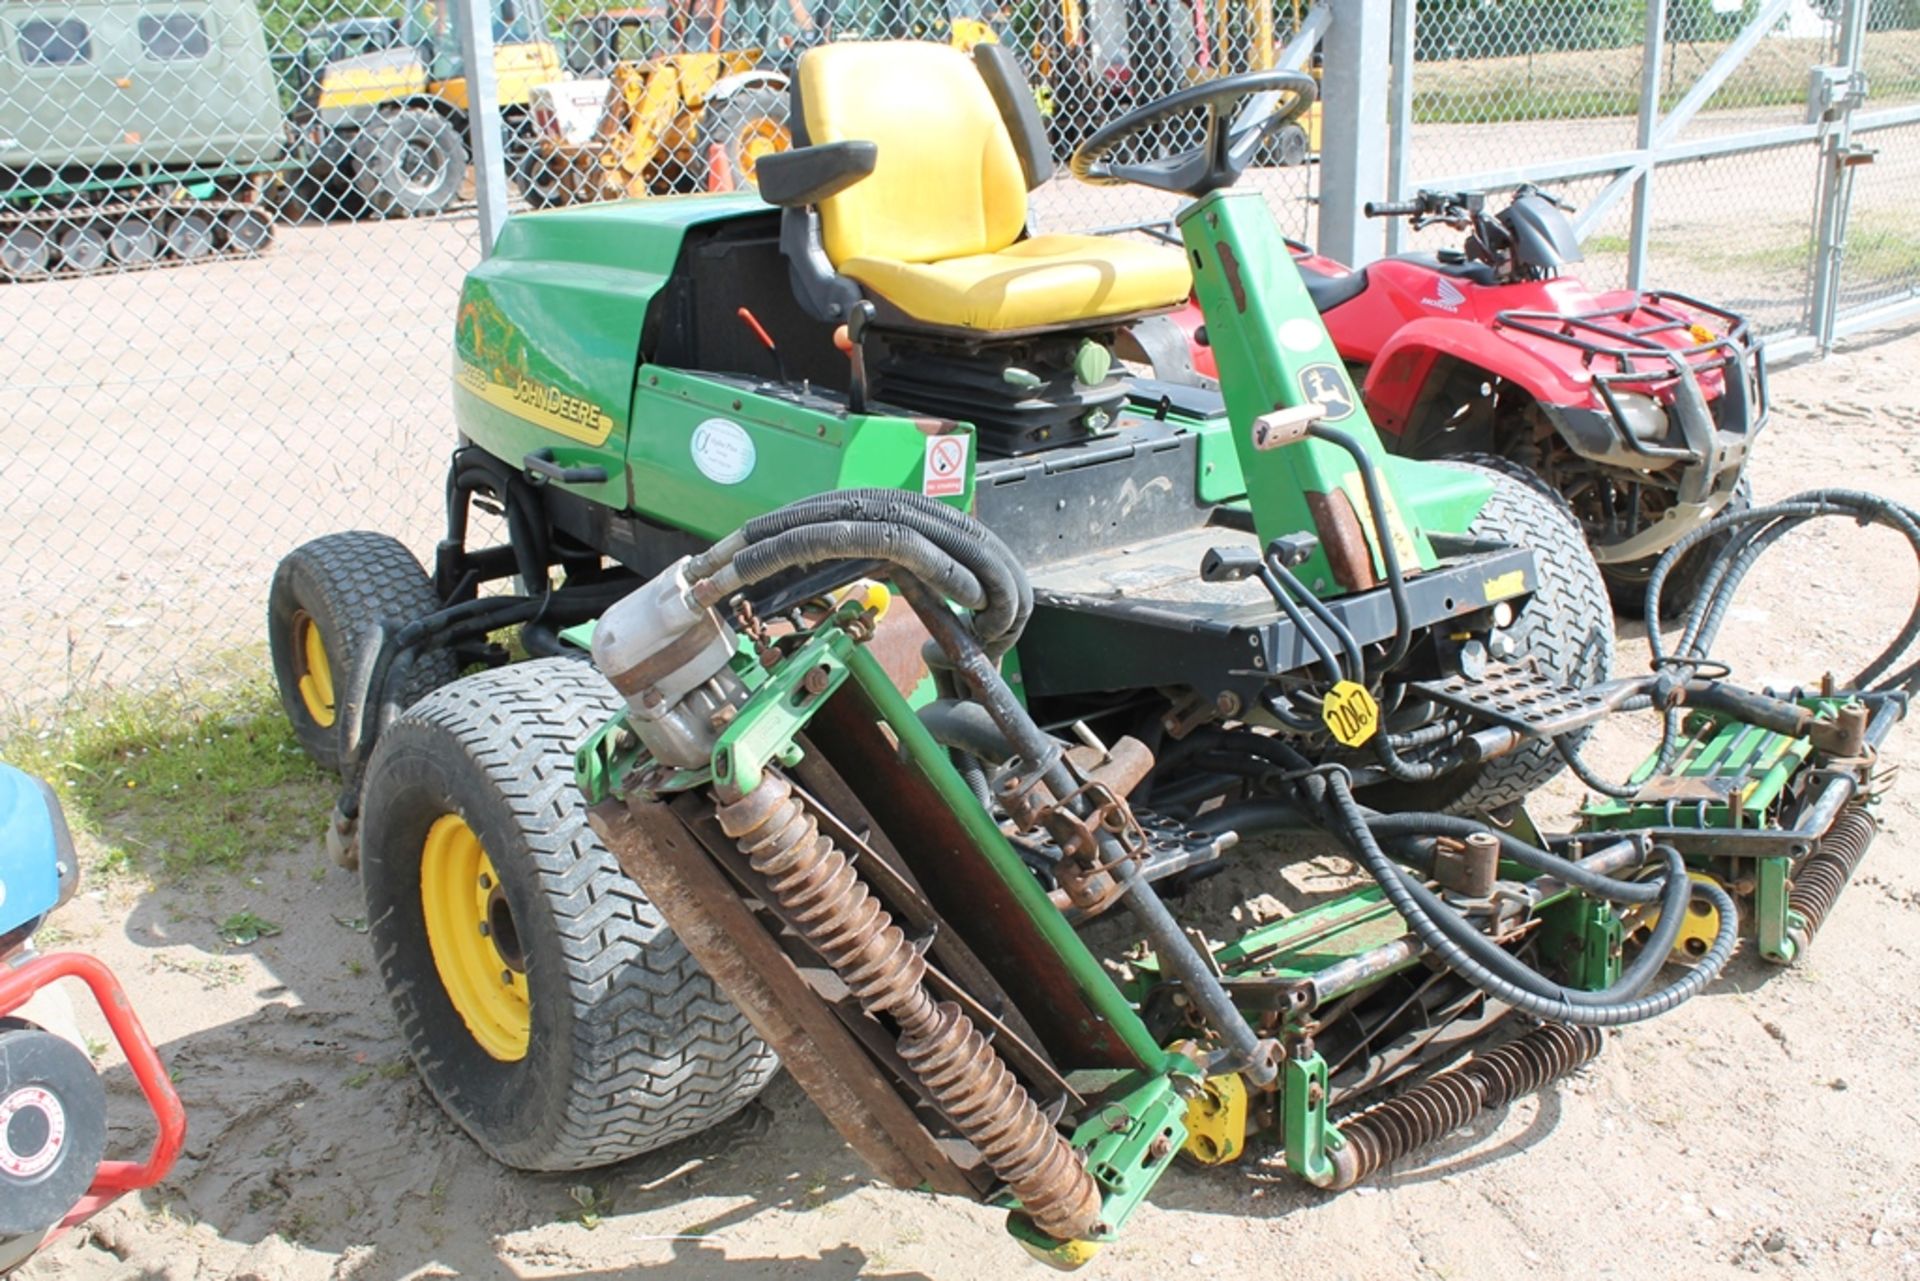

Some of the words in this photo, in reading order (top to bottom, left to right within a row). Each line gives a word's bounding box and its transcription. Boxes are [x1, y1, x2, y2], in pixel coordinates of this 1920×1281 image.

[1420, 297, 1459, 314] HONDA
[513, 375, 548, 412] JOHN
[548, 386, 601, 430] DEERE
